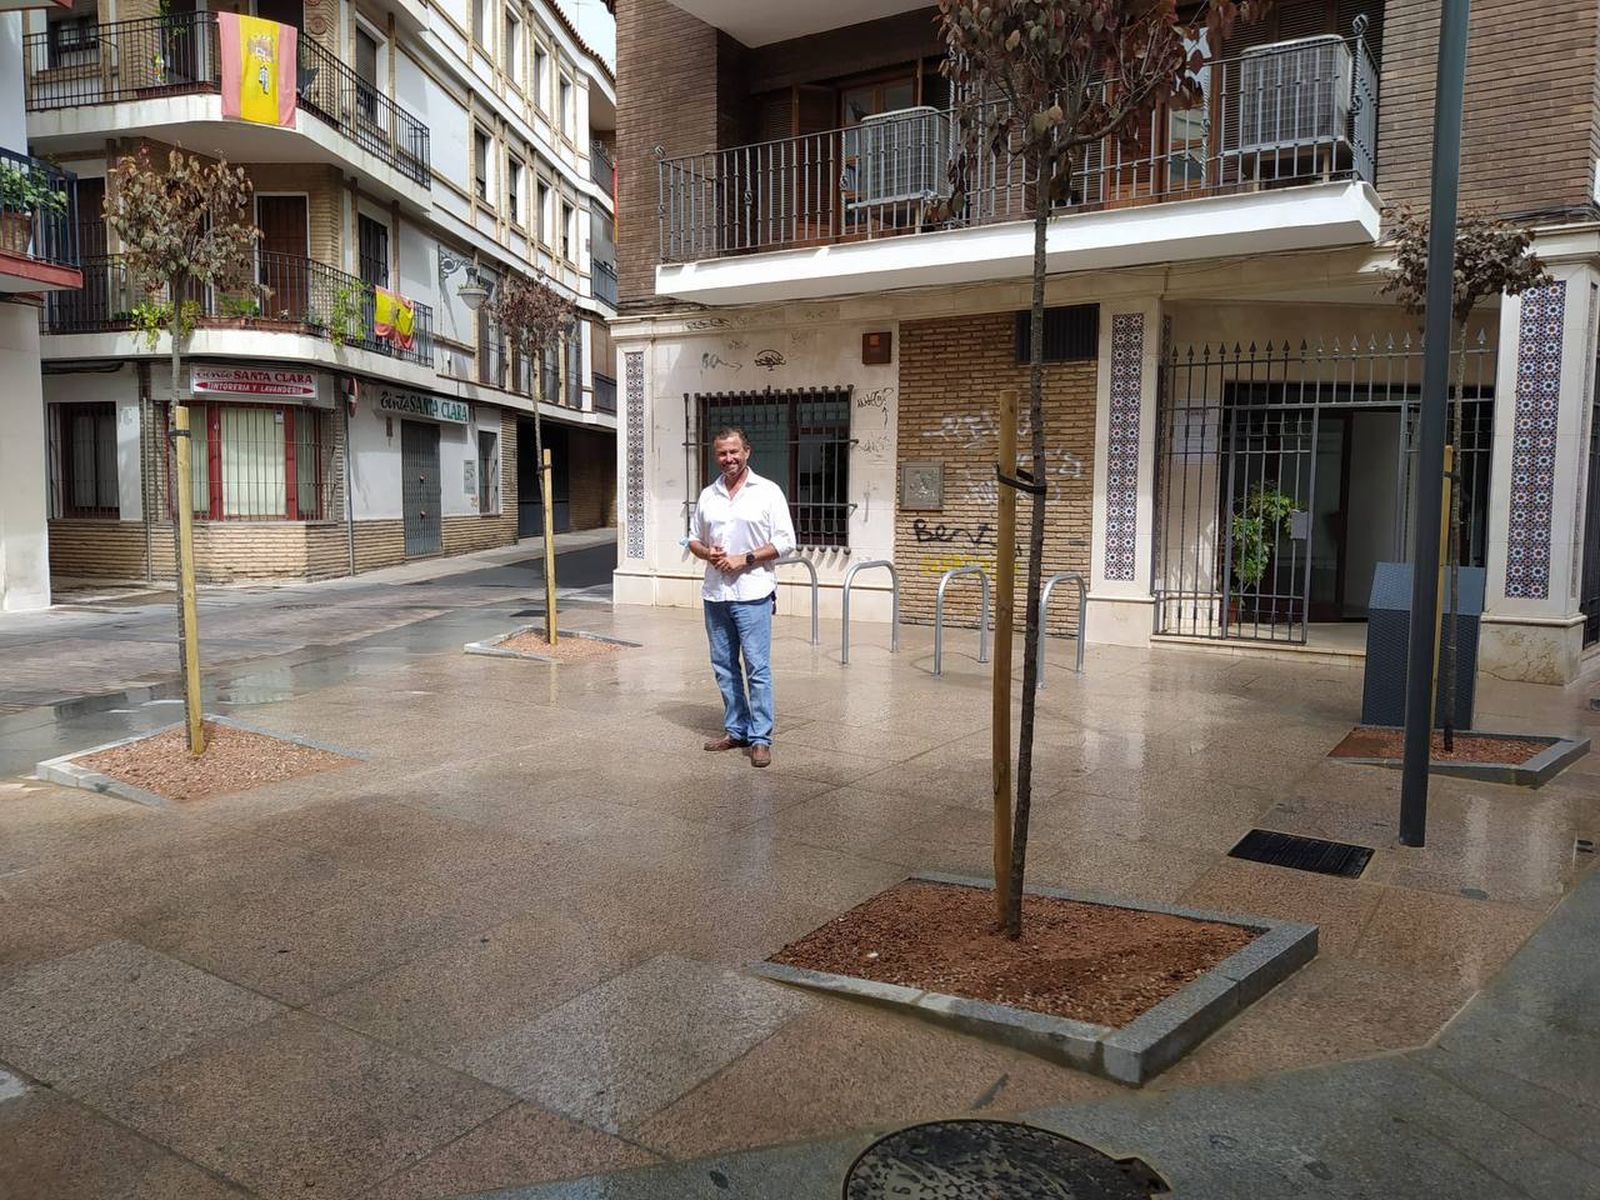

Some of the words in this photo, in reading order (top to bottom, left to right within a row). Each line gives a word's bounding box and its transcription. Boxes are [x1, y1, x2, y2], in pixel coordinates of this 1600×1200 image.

[233, 369, 270, 381] SANTA
[275, 372, 313, 384] CLARA
[409, 394, 439, 417] SANTA
[441, 402, 468, 422] CLARA
